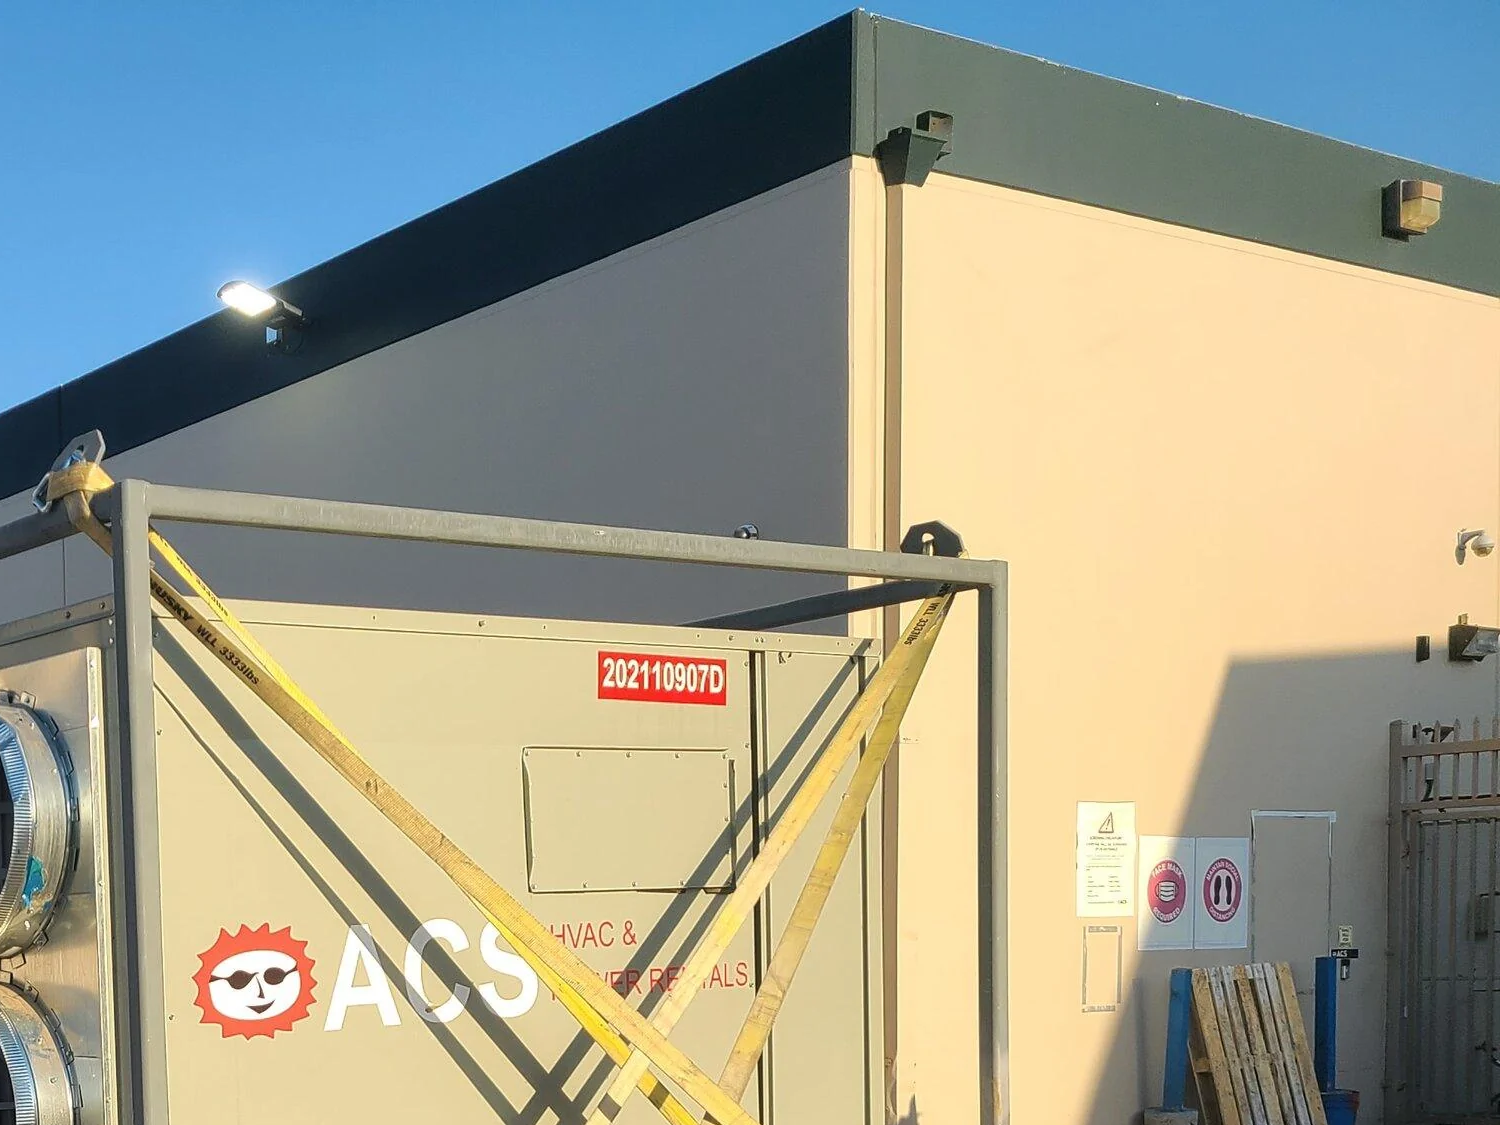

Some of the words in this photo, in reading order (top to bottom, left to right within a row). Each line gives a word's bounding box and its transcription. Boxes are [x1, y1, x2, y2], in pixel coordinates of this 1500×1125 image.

[196, 624, 218, 648] WLL
[219, 646, 260, 686] 3333lbs
[602, 657, 724, 694] 202110907D
[1152, 862, 1167, 879] FACE
[1167, 861, 1183, 879] MASK
[1153, 906, 1181, 922] REQUIRED
[551, 921, 615, 949] HVAC
[623, 920, 638, 946] &
[324, 918, 539, 1032] ACS
[649, 961, 749, 993] REALS
